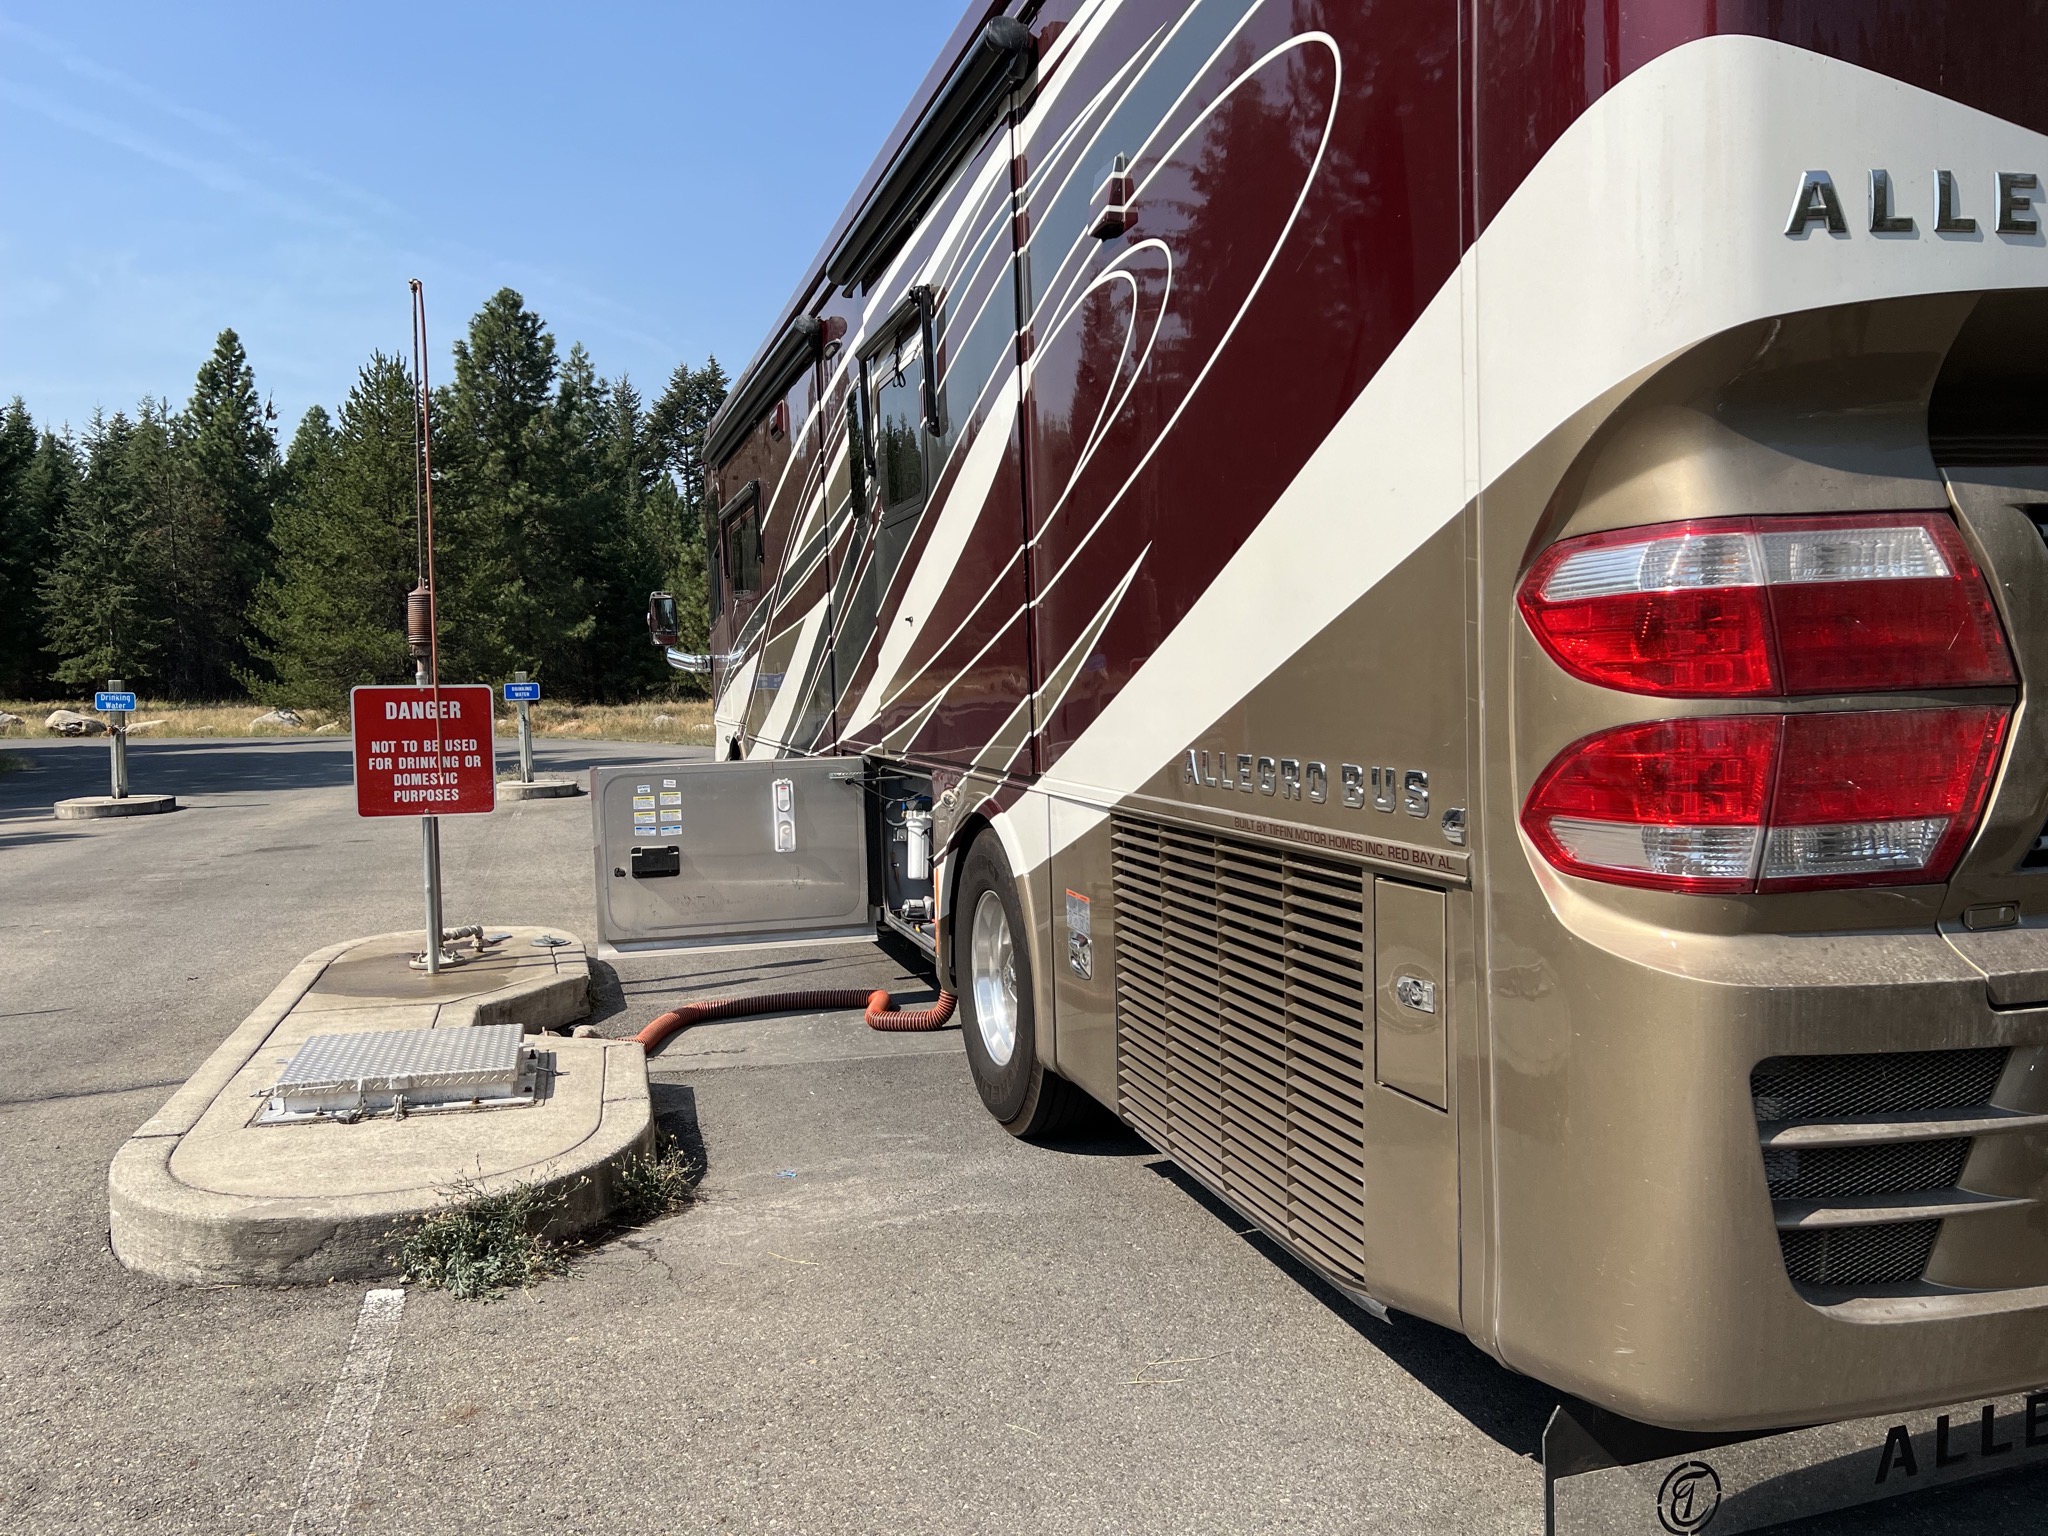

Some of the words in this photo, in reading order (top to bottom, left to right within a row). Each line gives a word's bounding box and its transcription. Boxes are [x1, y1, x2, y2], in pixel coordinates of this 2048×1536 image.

[101, 694, 131, 703] Drinking
[385, 701, 461, 720] DANGER
[371, 740, 397, 753] NOT
[401, 740, 418, 753] TO
[423, 739, 439, 752] BE
[445, 739, 478, 752] USED
[368, 757, 392, 770] FOR
[398, 756, 459, 770] DRINKNG
[465, 755, 481, 768] OR
[1183, 748, 1328, 804] ALLEGRO
[1341, 762, 1430, 818] BUS
[393, 788, 459, 803] PURPOSES
[1234, 817, 1256, 833] BUILT
[1256, 821, 1267, 835] BY
[1267, 823, 1294, 839] TIFFIN
[1294, 828, 1327, 846] MOTOR
[1328, 834, 1363, 853] HOMES
[1364, 841, 1386, 857] INC.
[1388, 846, 1410, 863] RED
[1412, 850, 1435, 866] BAY
[1437, 855, 1456, 871] AL.
